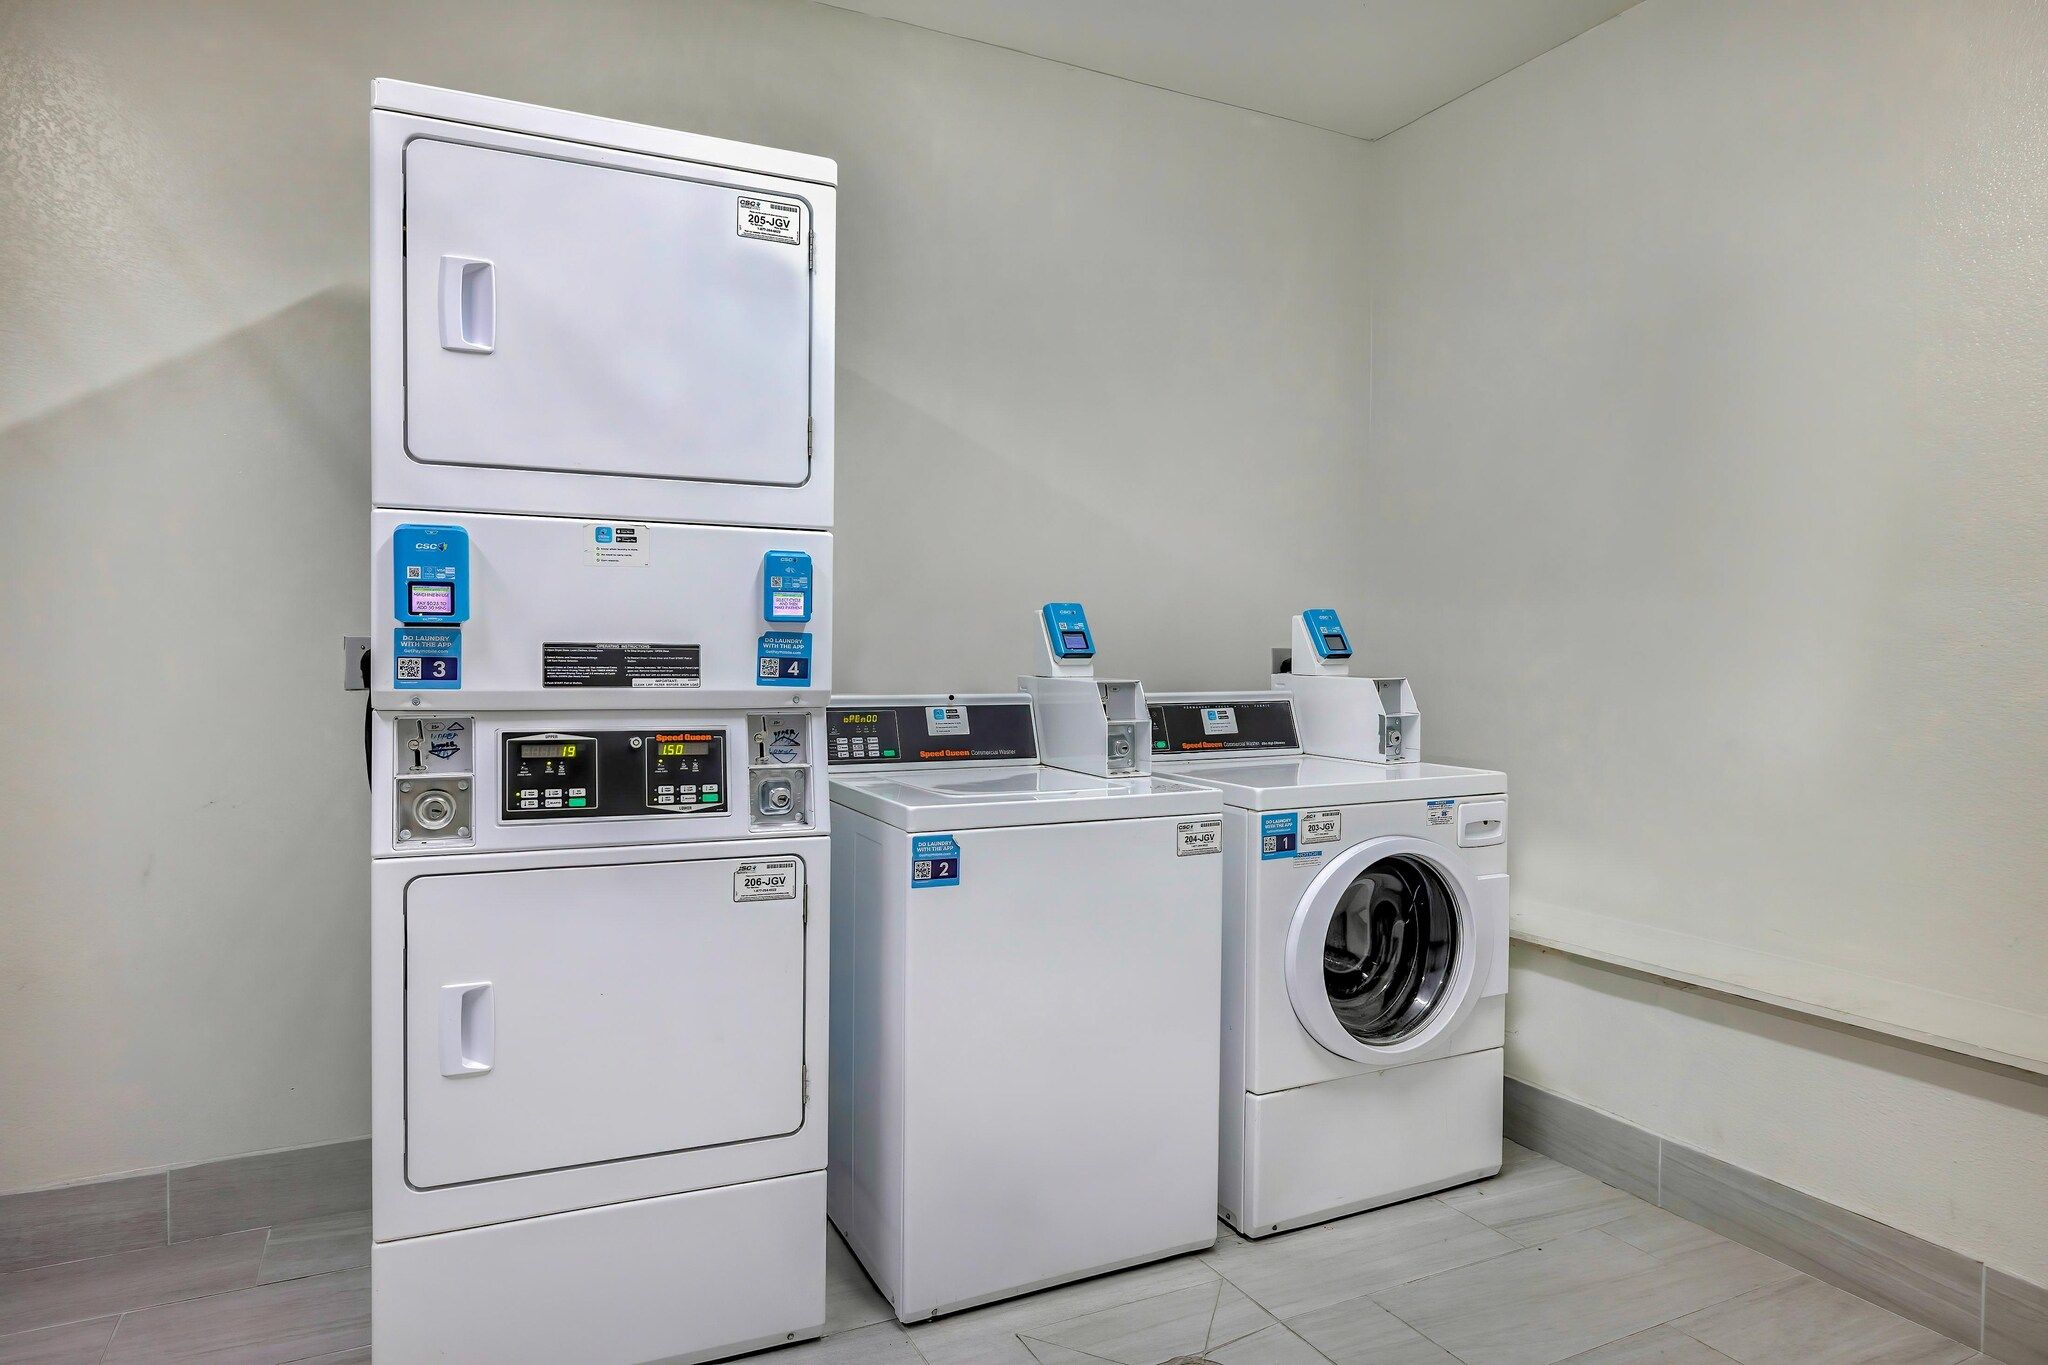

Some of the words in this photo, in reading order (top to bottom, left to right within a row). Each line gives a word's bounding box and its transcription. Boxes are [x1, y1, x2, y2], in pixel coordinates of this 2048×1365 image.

[748, 214, 790, 228] 205-JGV
[433, 661, 446, 677] 3
[788, 661, 799, 675] 4
[563, 746, 576, 756] 19
[920, 750, 944, 758] Speed
[1308, 823, 1335, 832] 203-JGV
[1185, 834, 1215, 843] 204-JGV
[1283, 837, 1288, 849] 1
[940, 862, 949, 876] 2
[745, 876, 786, 886] 206-JGV
